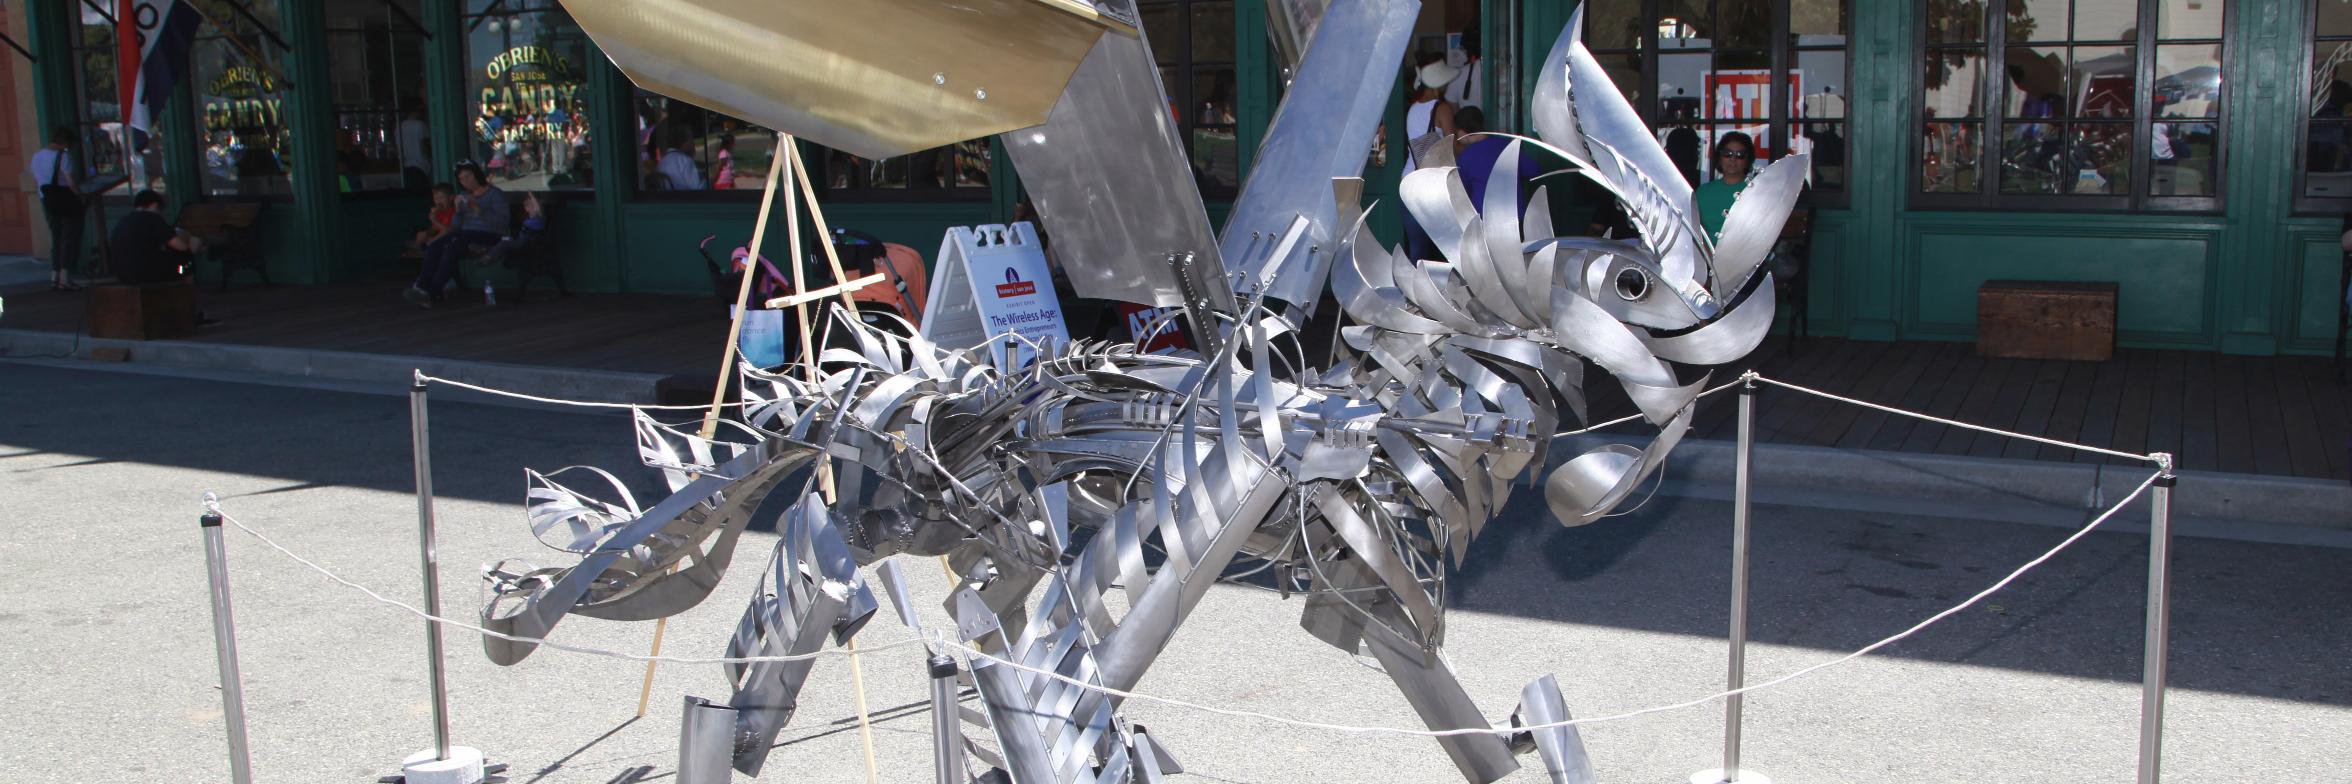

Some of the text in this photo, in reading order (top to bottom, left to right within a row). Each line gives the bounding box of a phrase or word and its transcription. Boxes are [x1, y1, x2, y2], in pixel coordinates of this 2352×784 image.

[487, 46, 568, 79] O'BRIEN'S
[511, 72, 525, 82] SAN
[206, 99, 281, 129] CANDY
[481, 83, 577, 117] CANDY
[991, 308, 1057, 327] The Wireless Age:
[1024, 323, 1057, 335] Entrepreneurs
[1128, 306, 1179, 341] ATM
